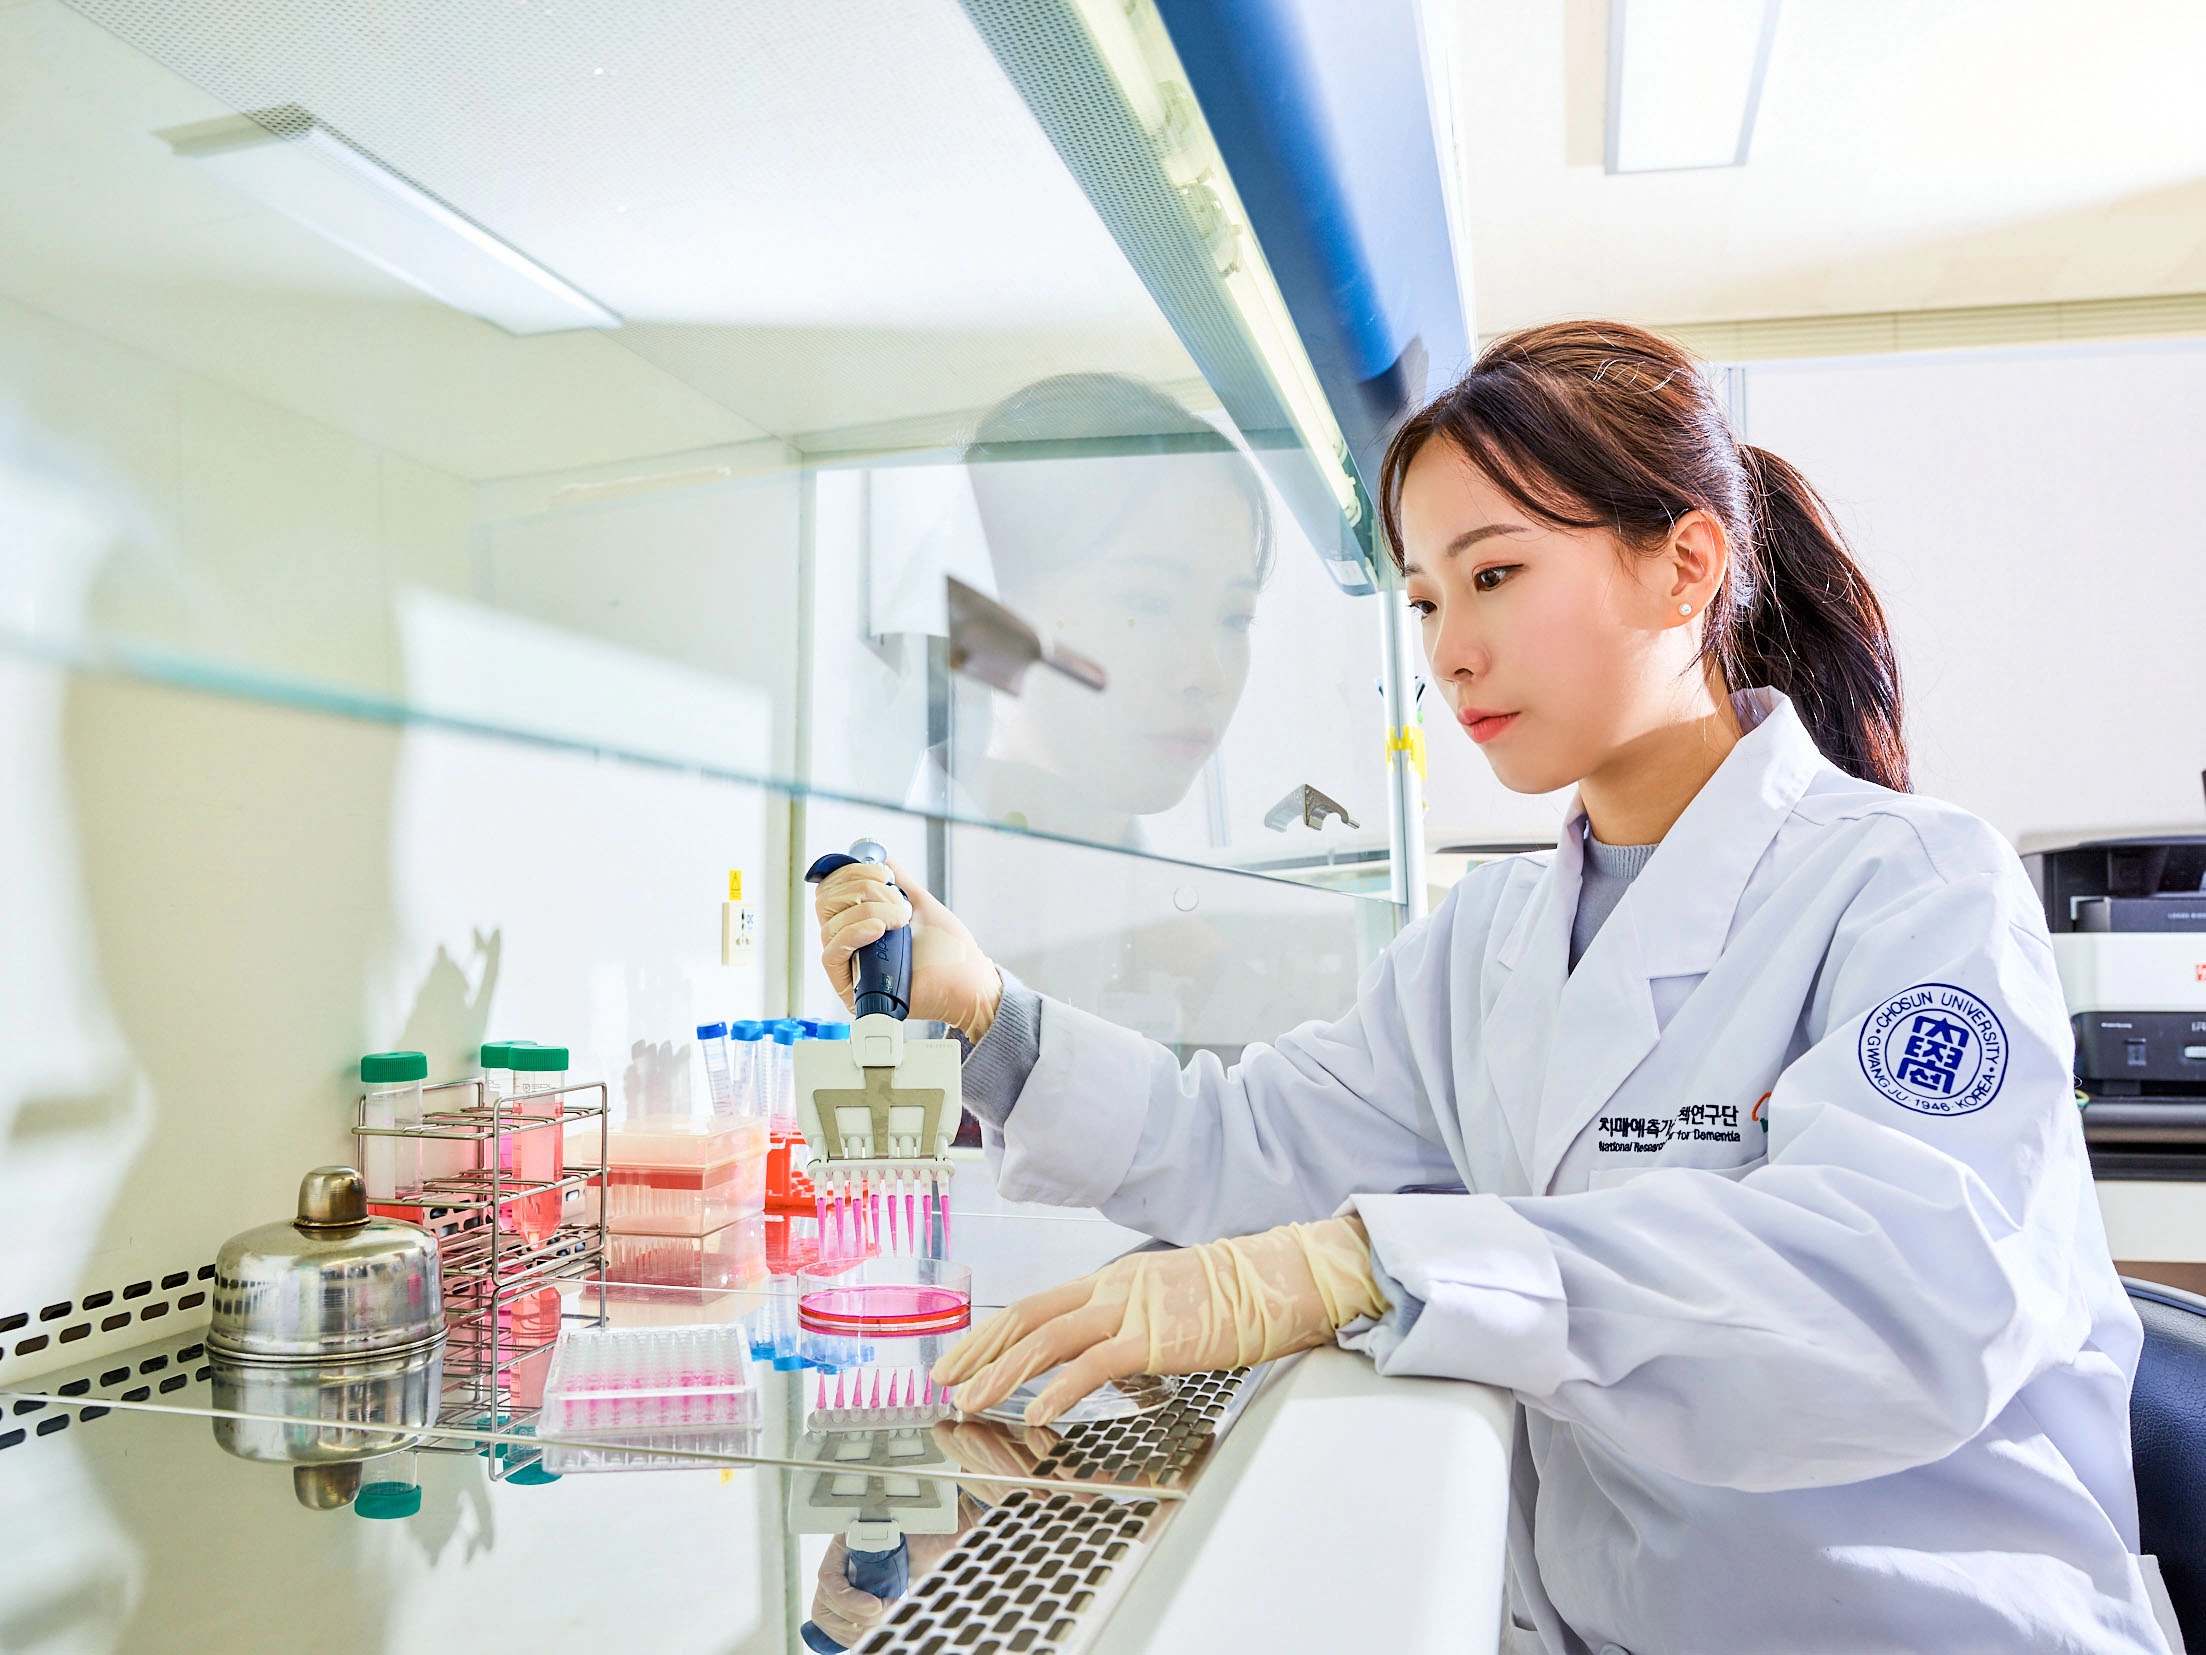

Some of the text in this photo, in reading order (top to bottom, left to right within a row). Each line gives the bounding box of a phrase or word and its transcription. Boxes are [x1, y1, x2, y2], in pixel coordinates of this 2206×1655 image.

[1876, 991, 2000, 1065] CHOSUN UNIVERSITY
[1915, 1099, 1951, 1112] 1946
[1954, 1074, 1996, 1109] KOREA
[1598, 1140, 1633, 1153] National
[1633, 1141, 1665, 1153] Resear
[1677, 1129, 1691, 1141] for
[1693, 1128, 1741, 1142] Dementia
